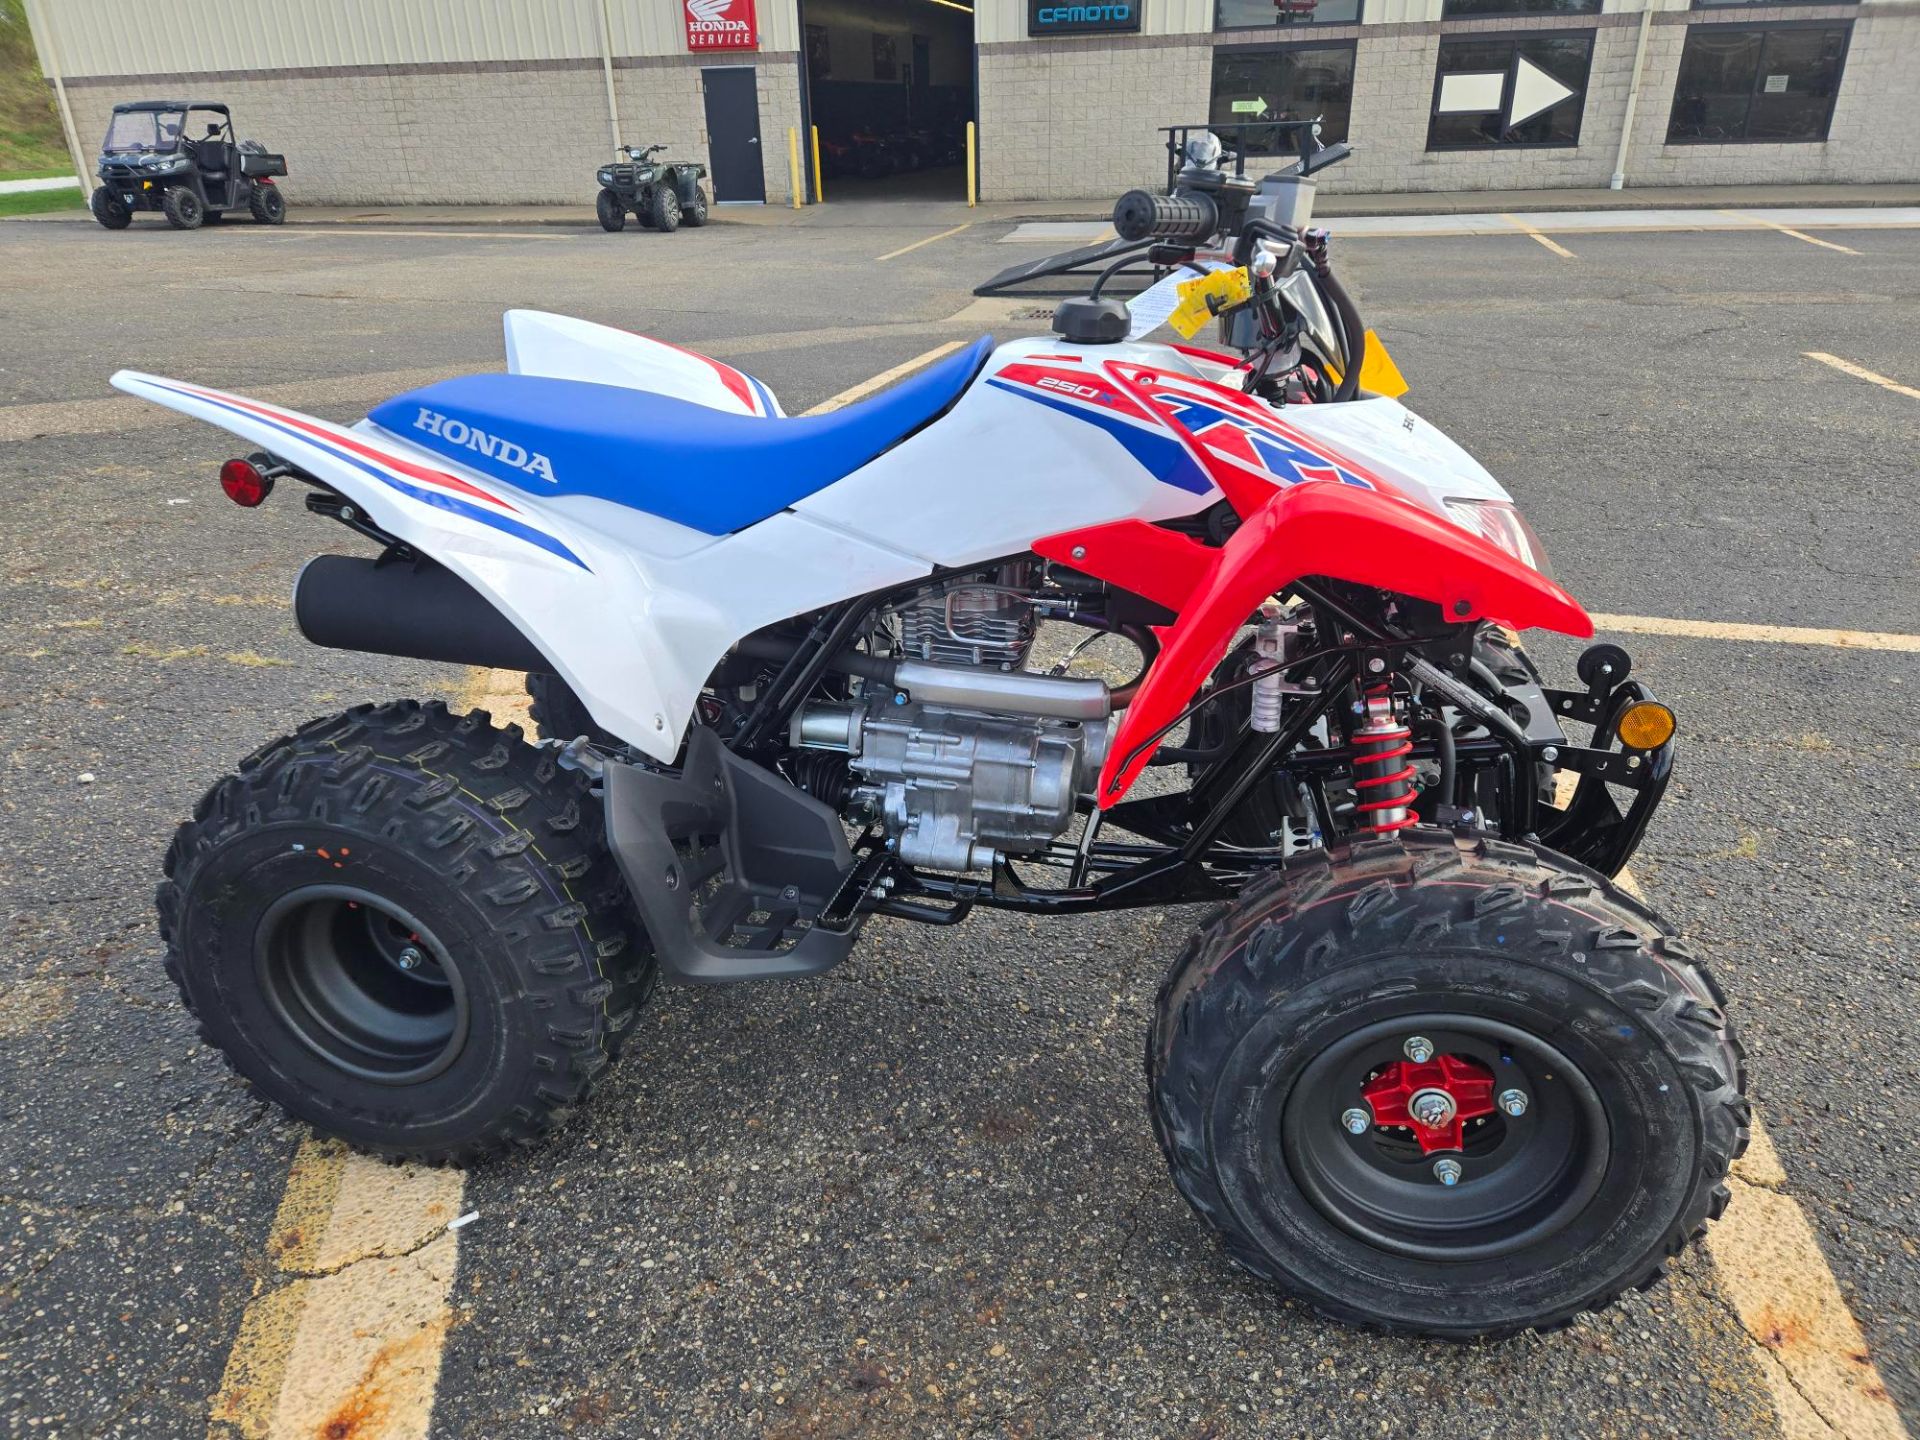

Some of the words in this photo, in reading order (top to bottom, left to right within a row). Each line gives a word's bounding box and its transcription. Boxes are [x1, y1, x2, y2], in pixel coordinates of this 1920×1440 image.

[1039, 5, 1129, 23] CFMOTO
[688, 20, 750, 32] HONDA
[690, 33, 750, 45] SERVICE
[413, 407, 558, 484] HONDA
